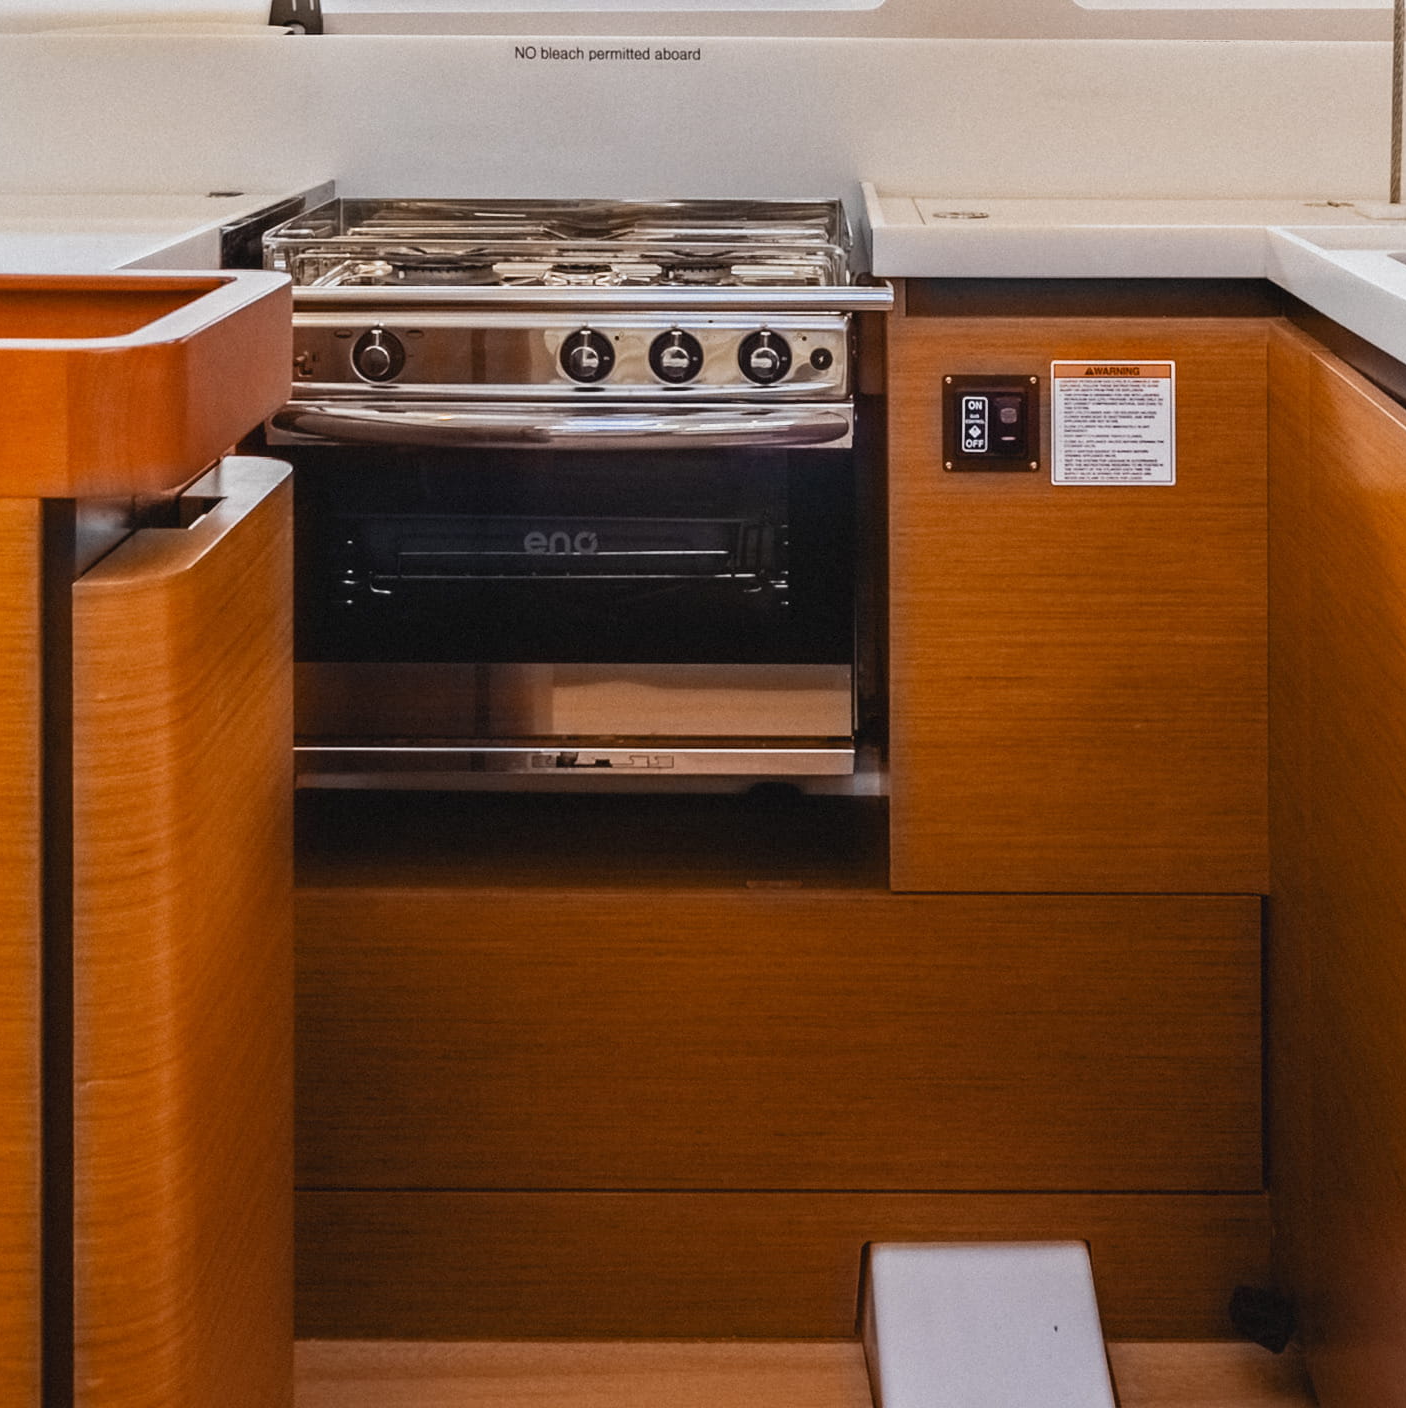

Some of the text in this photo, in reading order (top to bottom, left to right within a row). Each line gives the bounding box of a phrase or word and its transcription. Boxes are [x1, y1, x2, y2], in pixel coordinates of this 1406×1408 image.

[514, 46, 701, 62] NO bleach permitted aboard
[1093, 367, 1140, 376] WARNING
[968, 400, 983, 411] ON
[965, 438, 984, 448] OFF
[524, 531, 598, 555] eno
